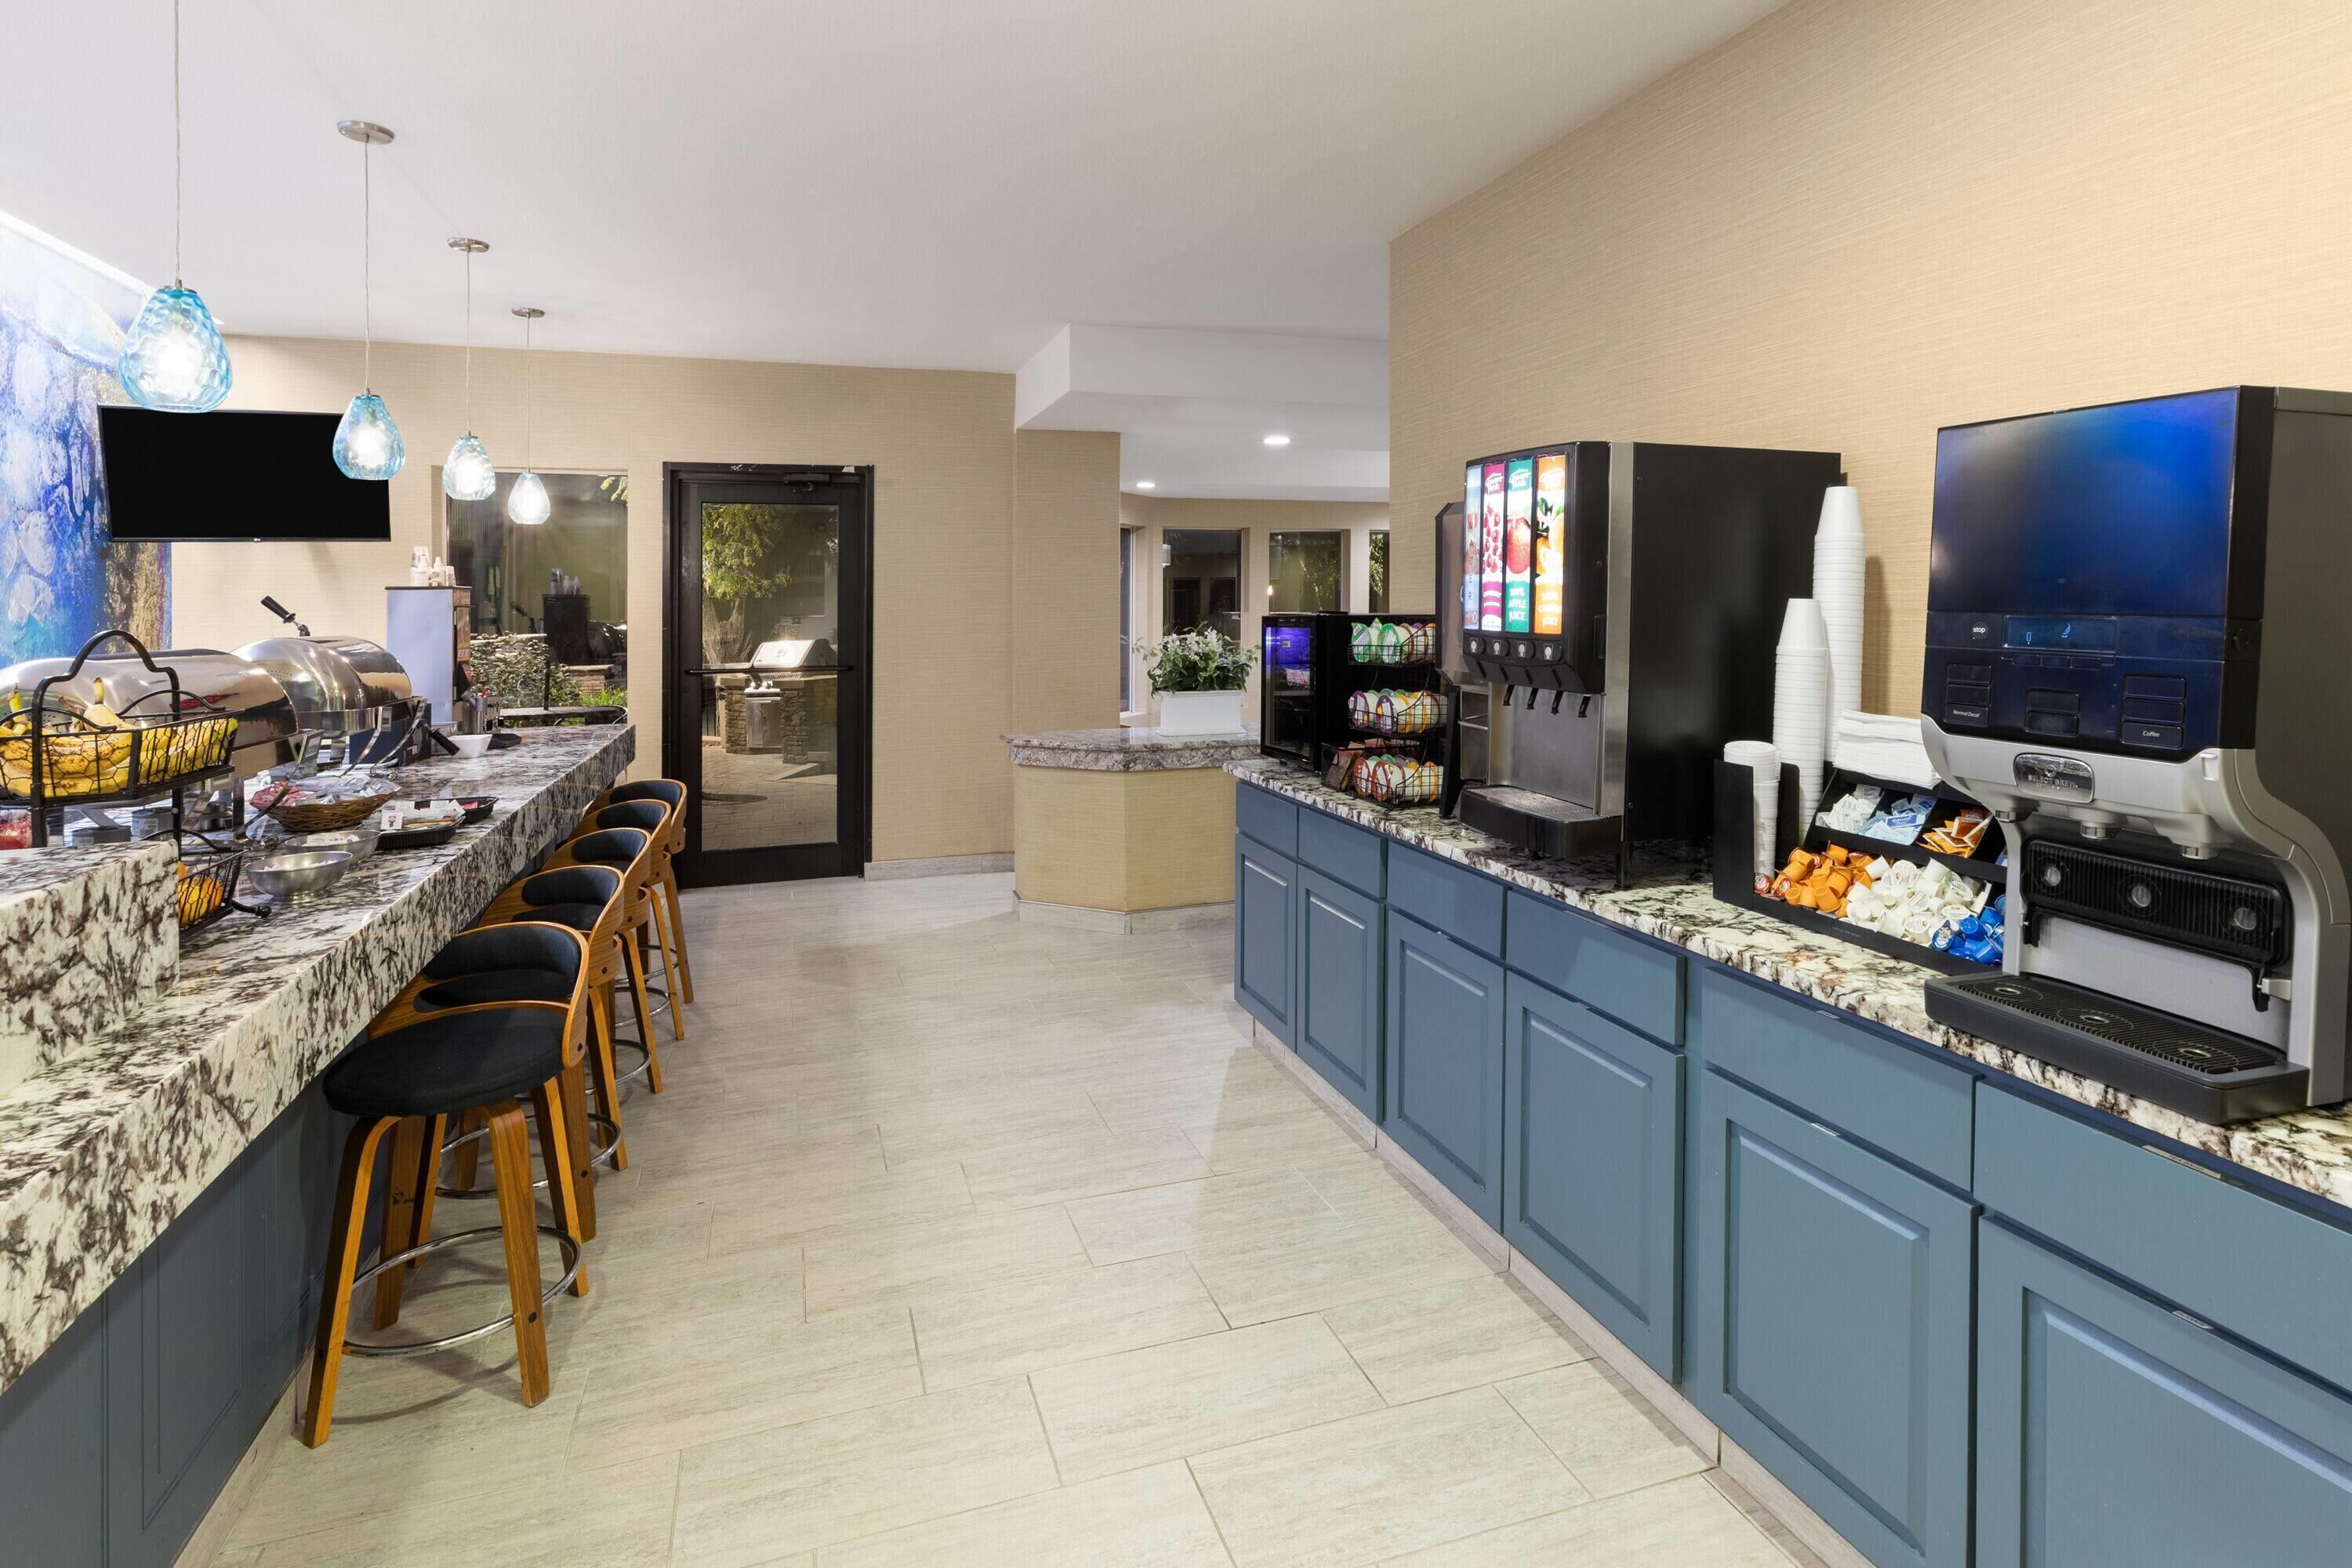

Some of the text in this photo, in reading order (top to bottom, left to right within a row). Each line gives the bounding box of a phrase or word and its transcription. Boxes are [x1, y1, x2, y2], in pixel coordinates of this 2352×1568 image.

[1509, 586, 1525, 597] 100%
[1508, 598, 1527, 609] APPLE
[1508, 611, 1526, 622] JUICE
[2027, 774, 2053, 785] SELECT
